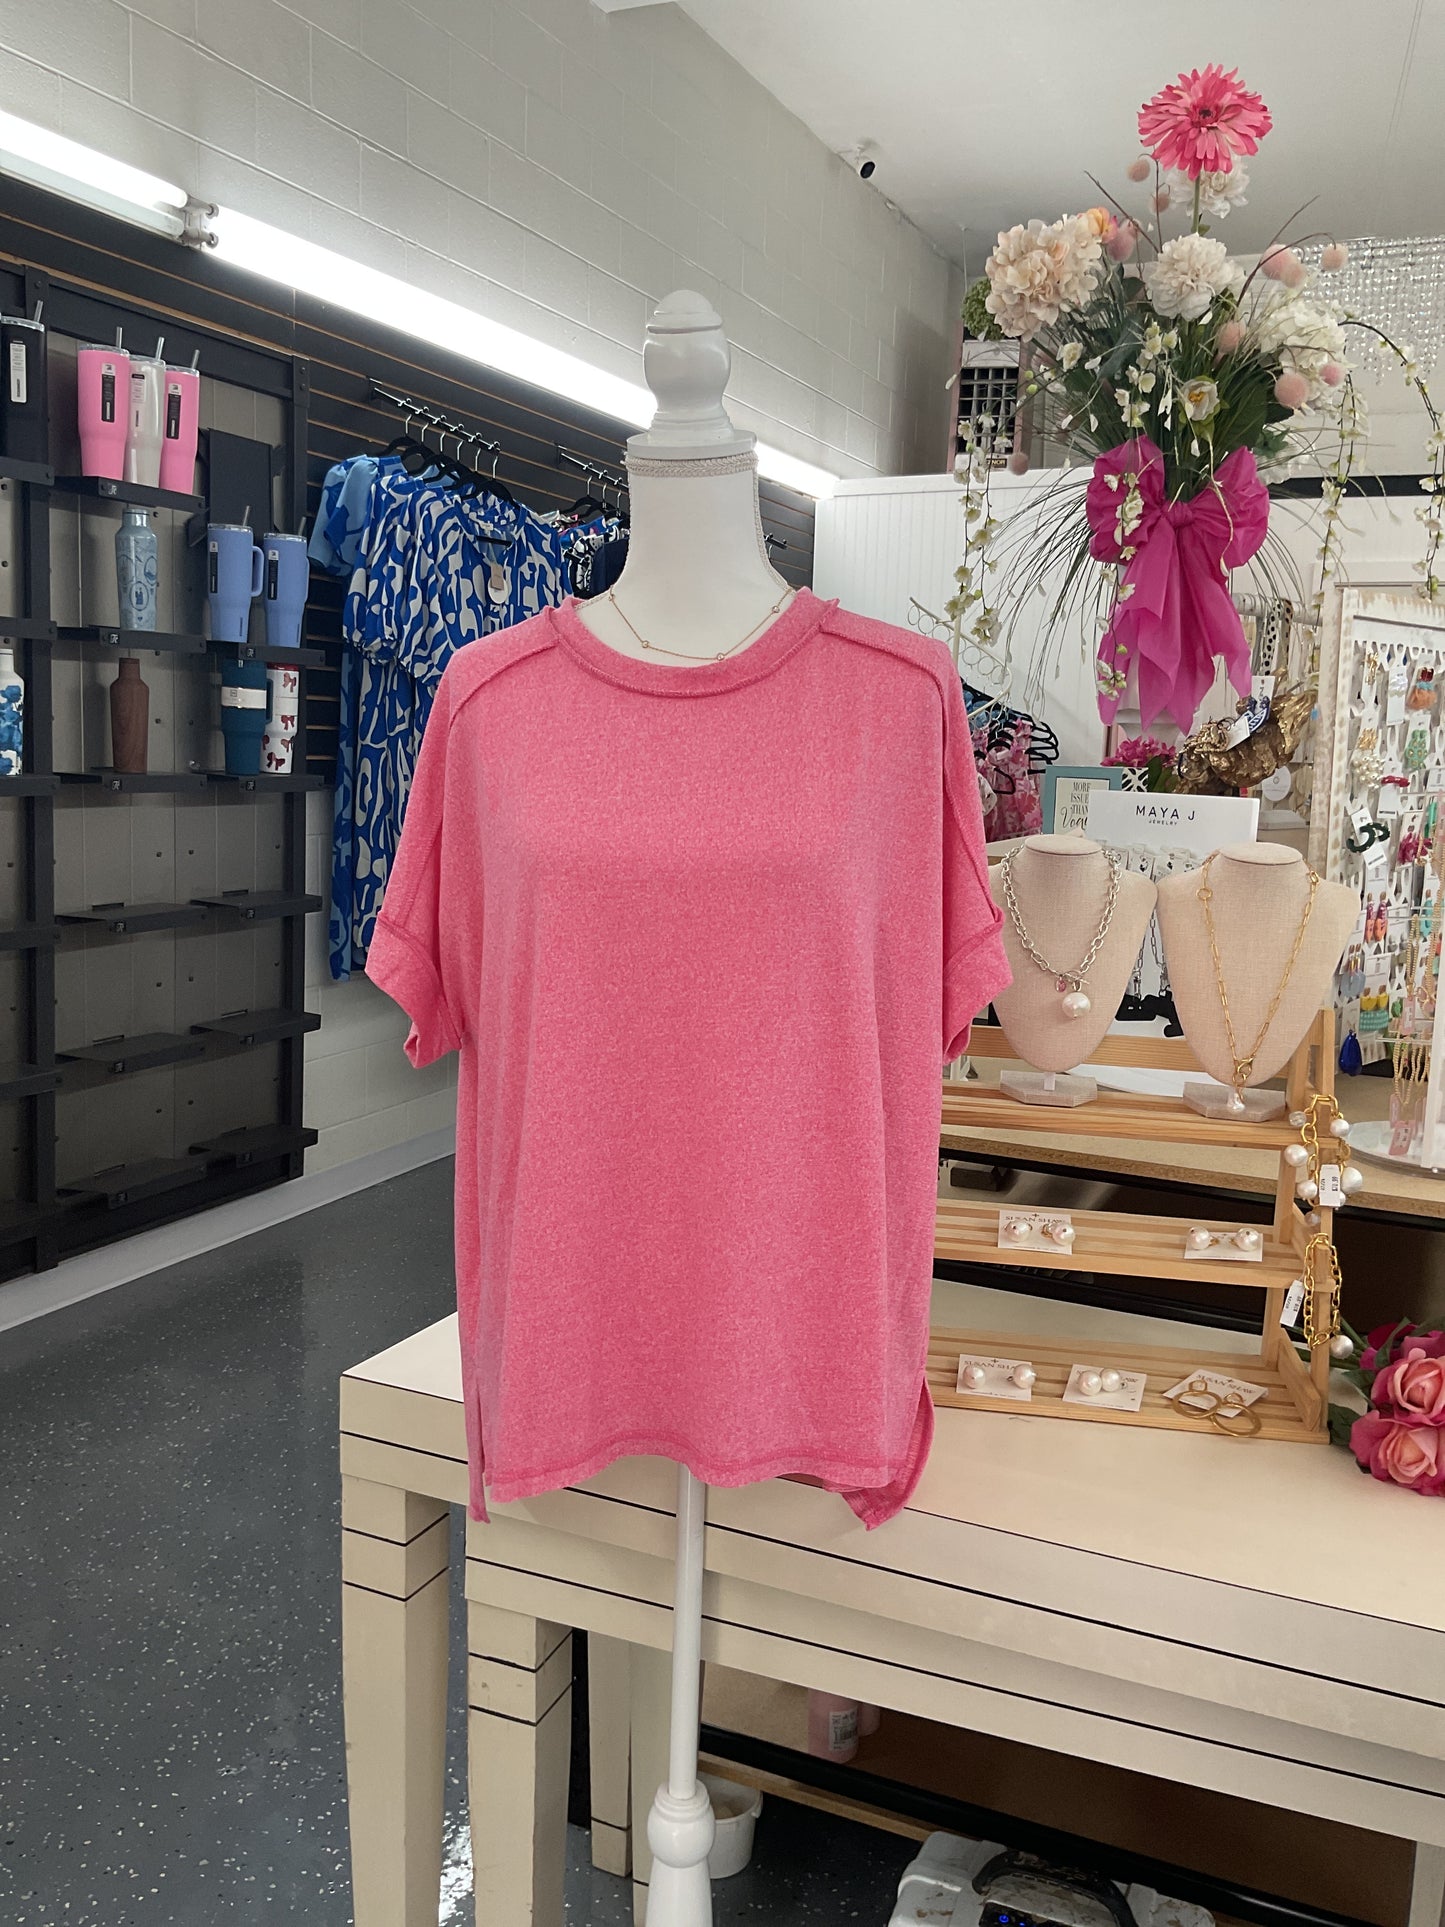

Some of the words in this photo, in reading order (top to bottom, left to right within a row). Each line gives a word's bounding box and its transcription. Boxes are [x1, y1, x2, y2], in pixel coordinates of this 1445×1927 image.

[1073, 782, 1092, 792] MORE
[1071, 793, 1089, 803] ISSUE
[1135, 804, 1179, 820] MAYA
[1187, 810, 1195, 821] J
